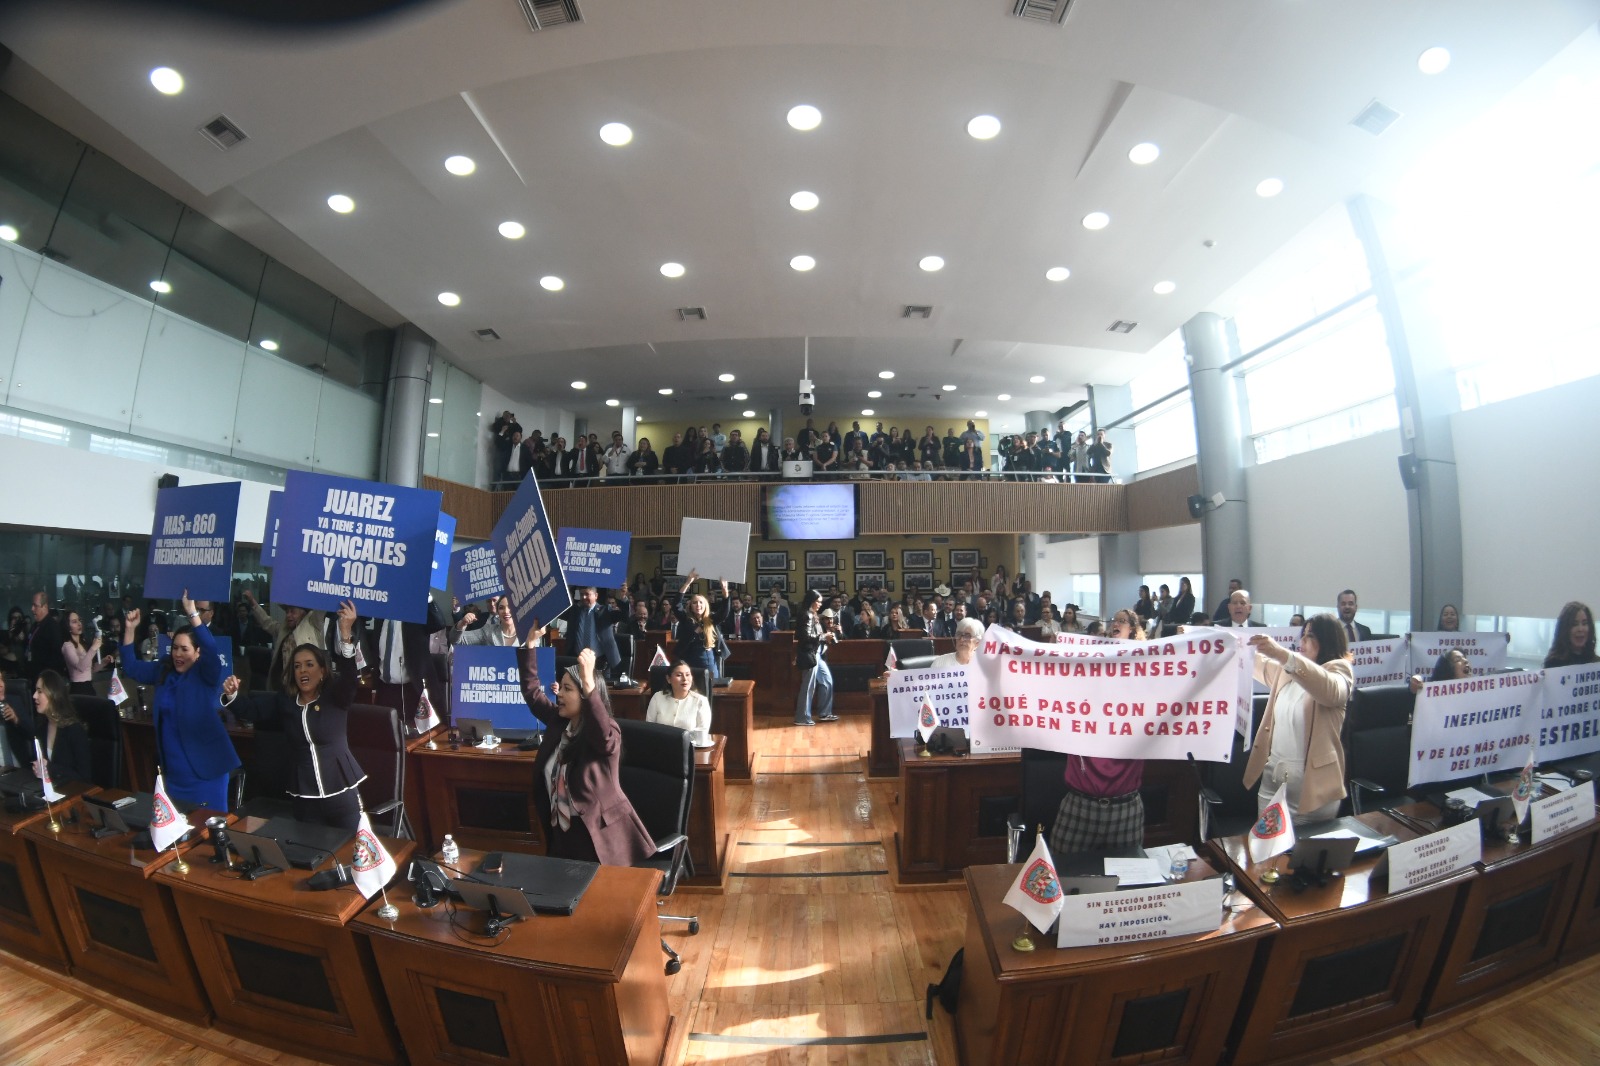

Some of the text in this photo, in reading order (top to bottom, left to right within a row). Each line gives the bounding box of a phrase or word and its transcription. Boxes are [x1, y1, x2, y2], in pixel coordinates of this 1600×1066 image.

[322, 488, 395, 522] JUAREZ
[163, 514, 185, 535] MAS
[192, 513, 216, 535] 860
[318, 516, 395, 539] YA TIENE 3 RUTAS
[212, 537, 225, 547] CON
[301, 528, 407, 567] TRONCALES
[565, 541, 622, 555] MARU CAMPOS
[153, 547, 224, 566] MEDICHIHUAHUA
[464, 547, 485, 564] 390
[588, 557, 602, 568] KM
[323, 556, 378, 588] Y 100
[460, 557, 492, 573] PERSONAS
[469, 564, 499, 583] AGUA
[505, 529, 551, 608] SALUD
[307, 580, 389, 603] CAMIONES NUEVOS
[470, 576, 500, 593] POTABLE
[1057, 635, 1075, 645] SIN
[1116, 643, 1176, 657] PARA
[1187, 639, 1225, 655] LOS
[1376, 645, 1391, 653] SIN
[1438, 638, 1476, 646] PUEBLOS
[468, 666, 497, 682] MAS
[497, 672, 505, 680] DE
[918, 670, 965, 681] GOBIERNO
[1008, 659, 1197, 678] CHIHUAHUENSES,
[1575, 671, 1600, 684] INFOR
[472, 683, 501, 691] PERSONAS
[1355, 672, 1403, 685] TUDIANTES
[1426, 673, 1539, 698] TRANSPORTE PÚBLICO
[892, 683, 944, 694] ABANDONA
[935, 692, 969, 701] DISCAP
[978, 694, 1028, 711] ¿QUÉ
[1038, 698, 1091, 716] PASÓ
[1102, 702, 1145, 717] CON
[1155, 700, 1229, 717] PONER
[1541, 708, 1553, 720] LA
[1558, 701, 1589, 717] TORRE
[993, 713, 1211, 736] ORDEN EN LA CASA?
[1443, 704, 1522, 729] INEFICIENTE
[1539, 719, 1599, 747] ESTREL
[1417, 734, 1530, 761] Y DE LOS MÁS CAROS
[1450, 753, 1498, 772] DEL PAÍS
[1418, 845, 1446, 859] PLENITUD
[1086, 901, 1101, 909] SIN
[1147, 891, 1182, 902] DIRECTA
[1098, 922, 1116, 930] HAY
[1113, 929, 1167, 942] DEMOCRACIA
